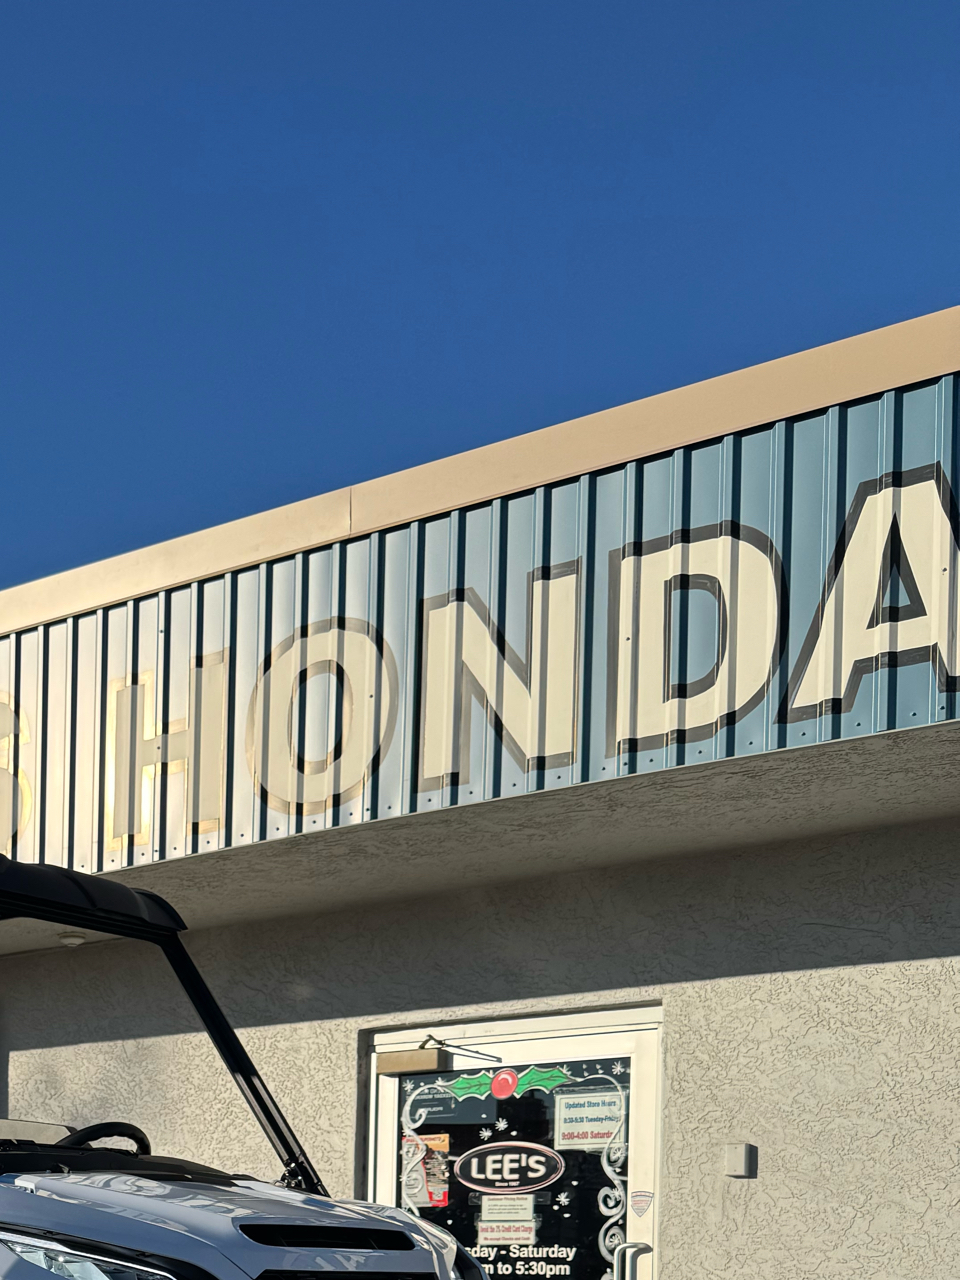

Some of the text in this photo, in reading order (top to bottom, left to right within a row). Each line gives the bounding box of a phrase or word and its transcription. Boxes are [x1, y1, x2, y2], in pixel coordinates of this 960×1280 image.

[108, 460, 960, 852] HONDA
[565, 1102, 586, 1110] Updated
[562, 1130, 613, 1140] 9:00-4:00 Saturd
[471, 1153, 546, 1180] LEE'S
[509, 1244, 577, 1261] Saturday
[497, 1262, 513, 1275] to
[515, 1261, 571, 1278] 5:30pm
